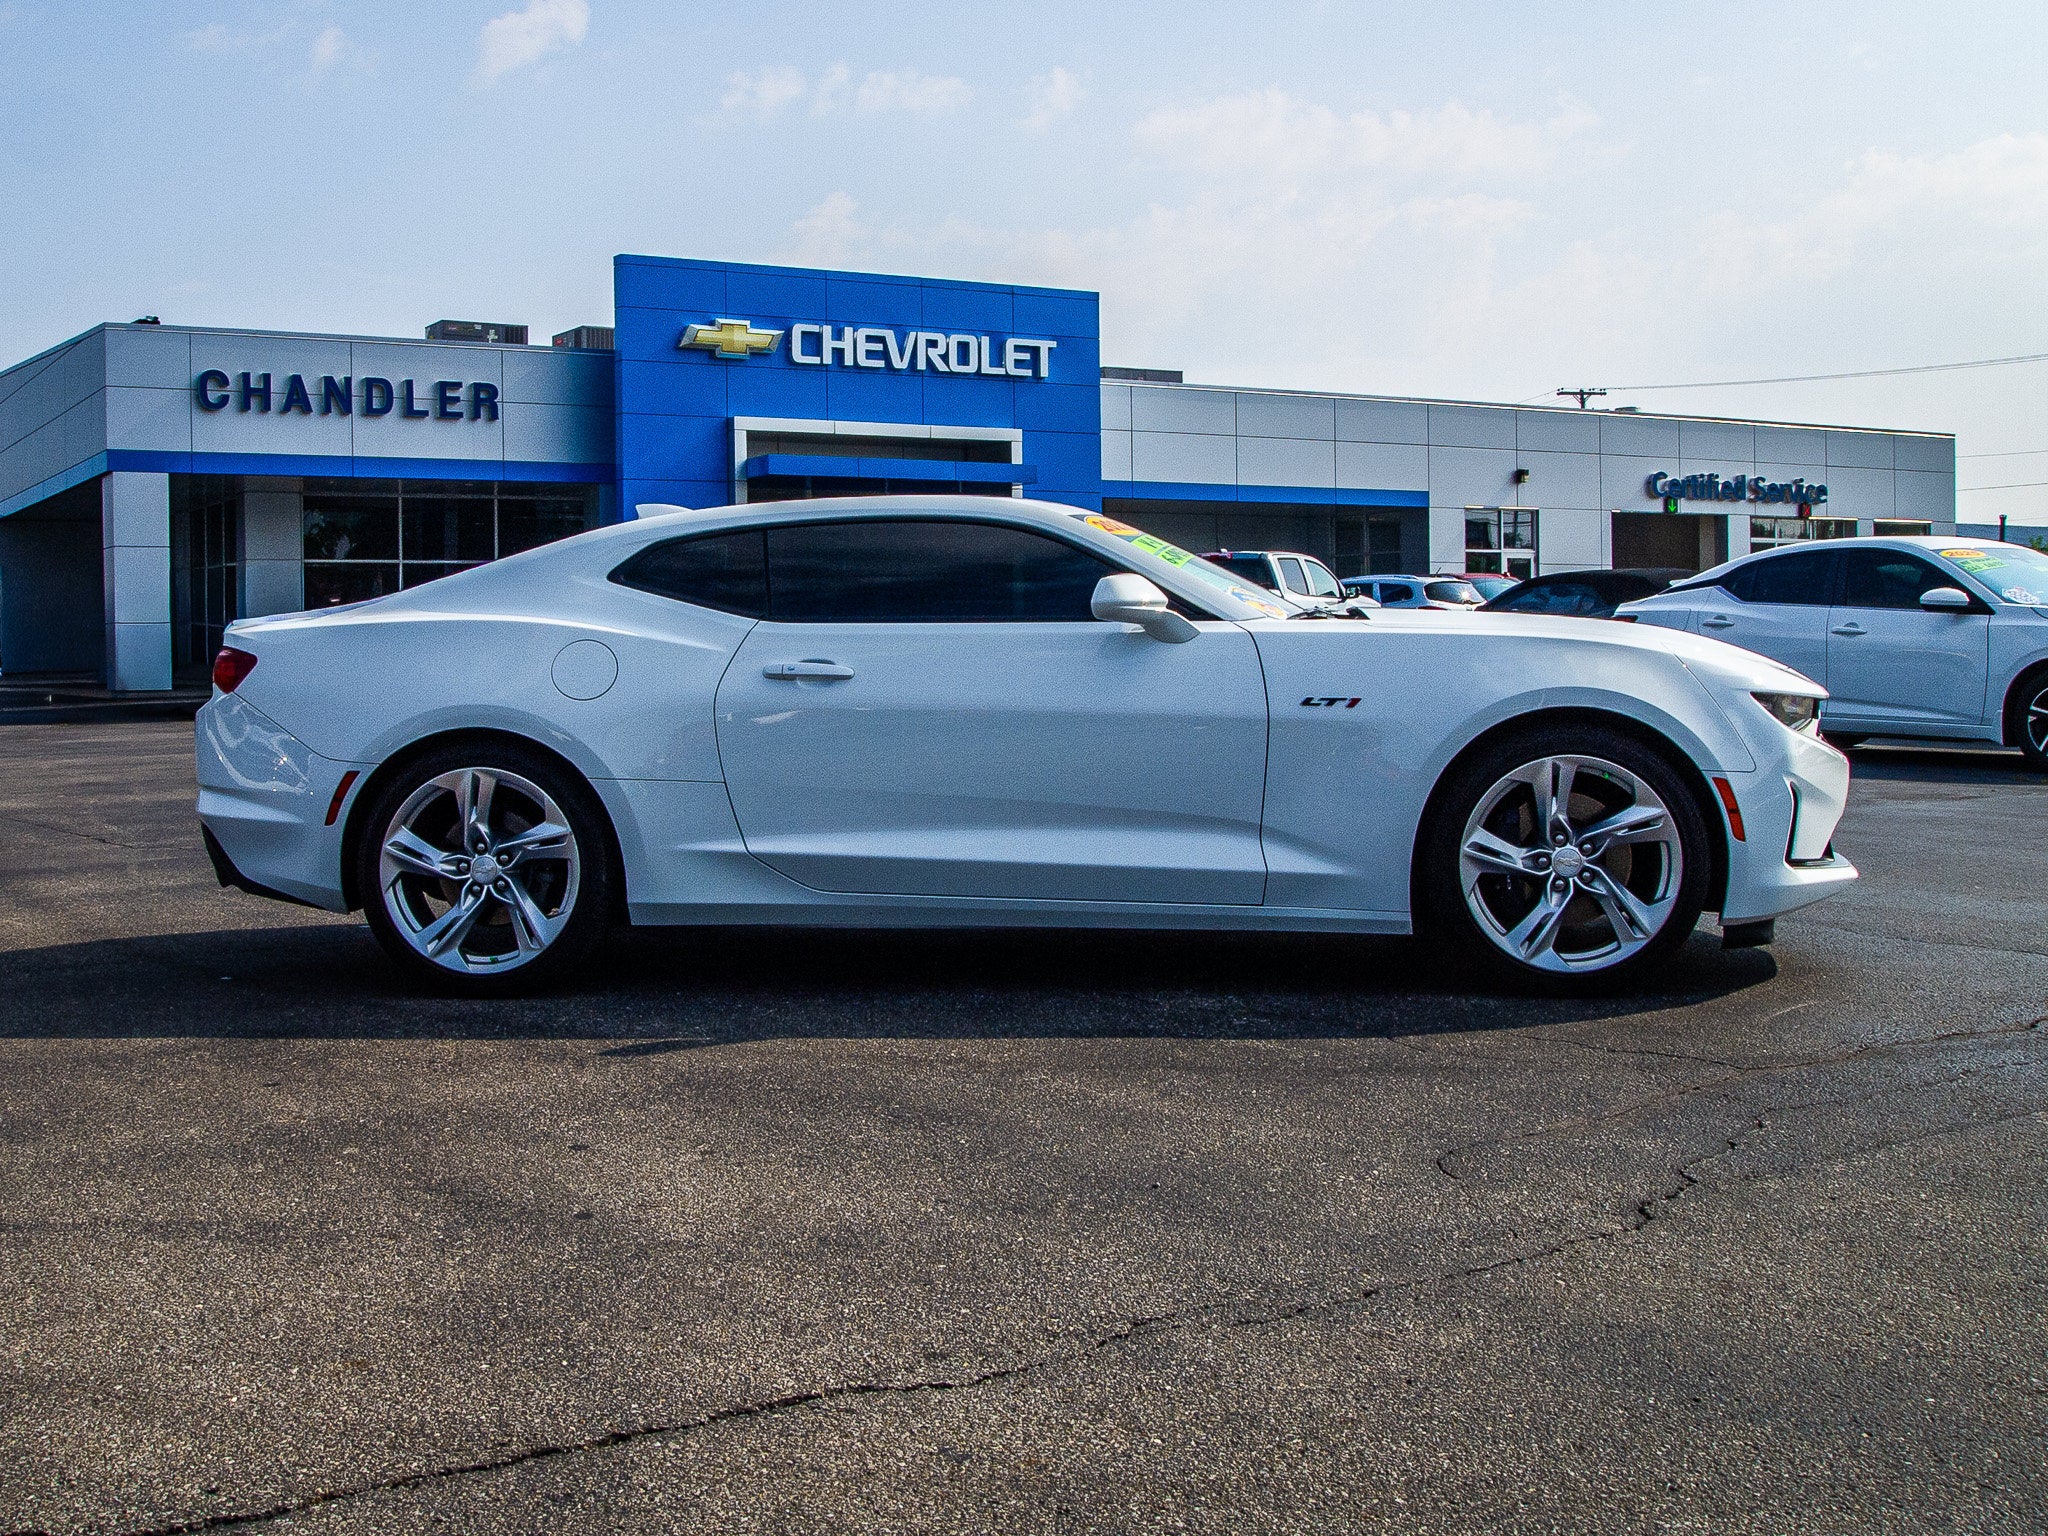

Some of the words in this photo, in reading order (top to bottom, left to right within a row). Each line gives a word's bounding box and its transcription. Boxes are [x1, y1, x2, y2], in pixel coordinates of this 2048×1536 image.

[791, 323, 1057, 378] CHEVROLET
[197, 369, 499, 421] CHANDLER
[1649, 471, 1746, 501] Certified
[1749, 476, 1828, 504] Service
[1300, 697, 1362, 708] LT1
